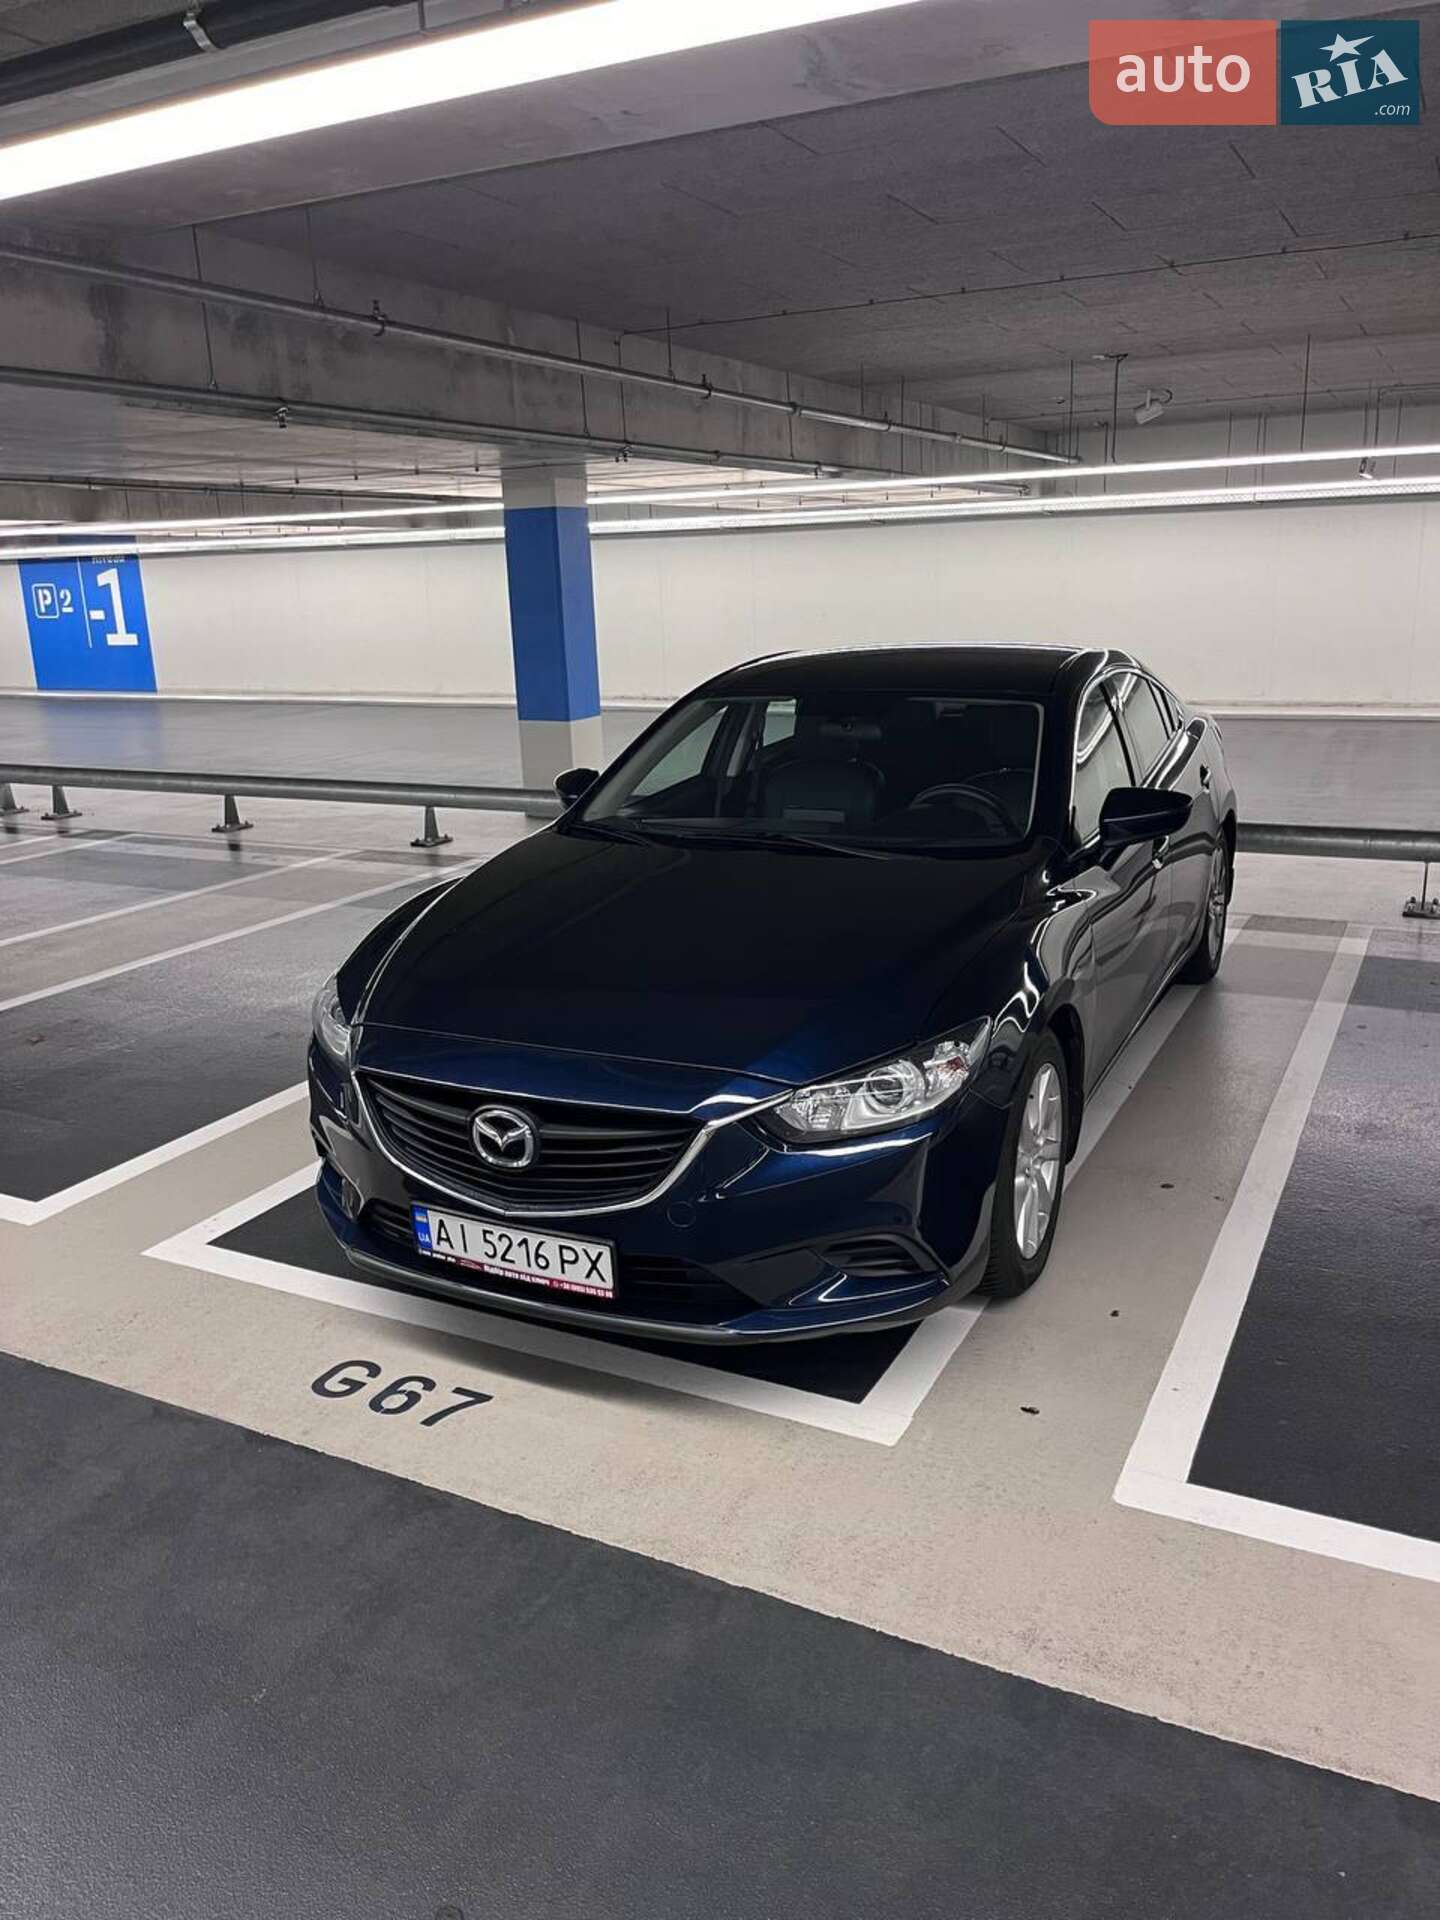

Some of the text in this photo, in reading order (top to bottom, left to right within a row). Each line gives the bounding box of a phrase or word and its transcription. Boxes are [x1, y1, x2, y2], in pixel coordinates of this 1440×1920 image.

[37, 588, 75, 613] P 2
[89, 567, 139, 646] -1
[418, 1231, 431, 1244] UA
[436, 1218, 607, 1283] AI 5216 PX
[311, 1359, 495, 1427] G67
